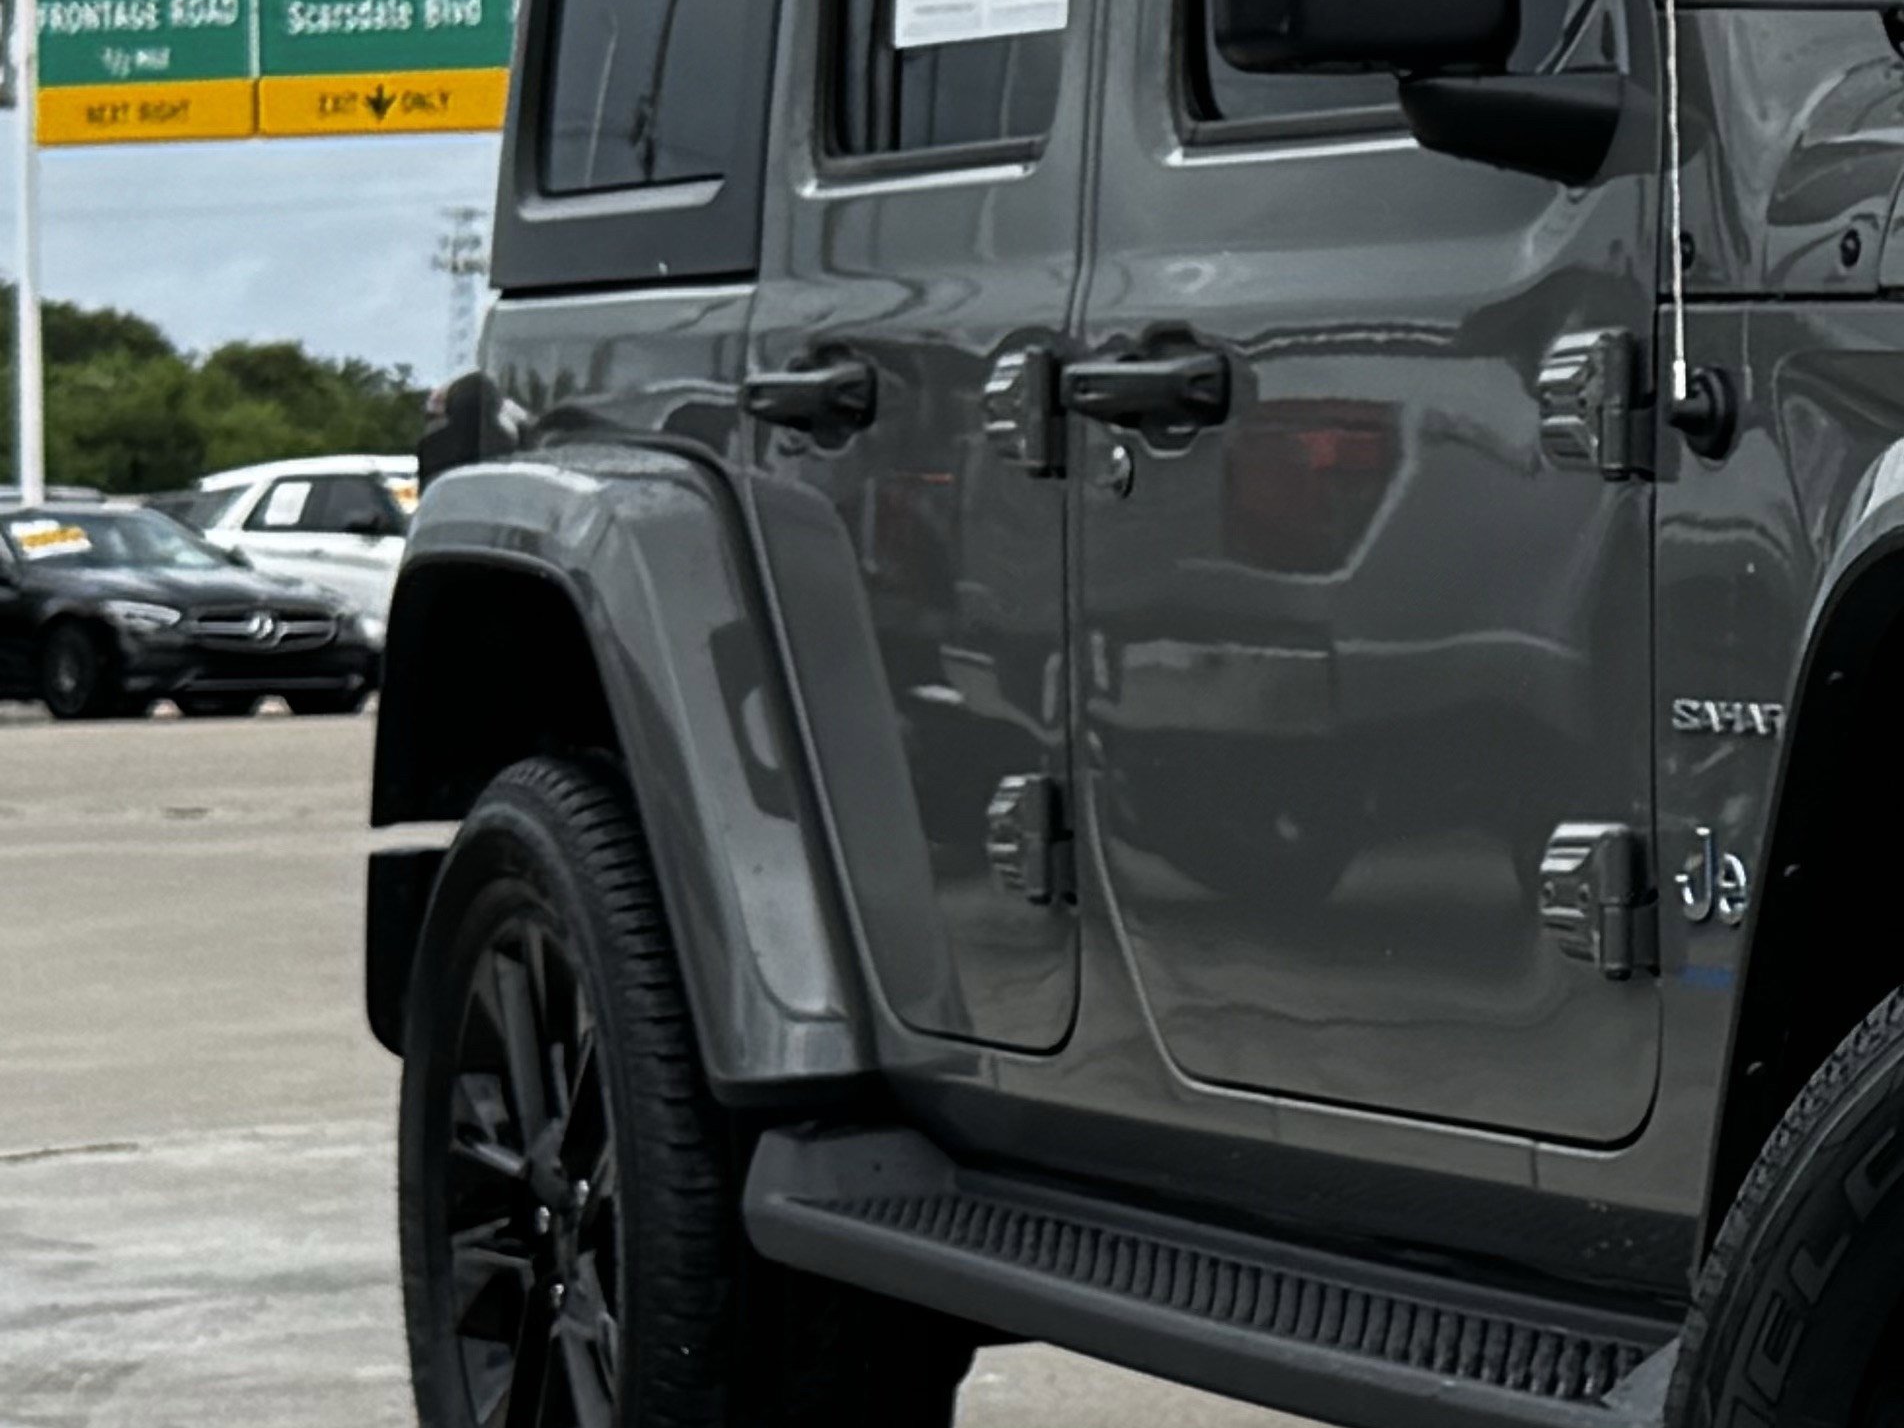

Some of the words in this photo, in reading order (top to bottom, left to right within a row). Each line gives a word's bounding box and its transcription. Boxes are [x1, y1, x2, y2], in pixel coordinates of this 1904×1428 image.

[86, 103, 130, 125] NEXT
[138, 98, 192, 123] RIGHT
[318, 91, 360, 118] EXIT
[401, 89, 451, 115] ONLY
